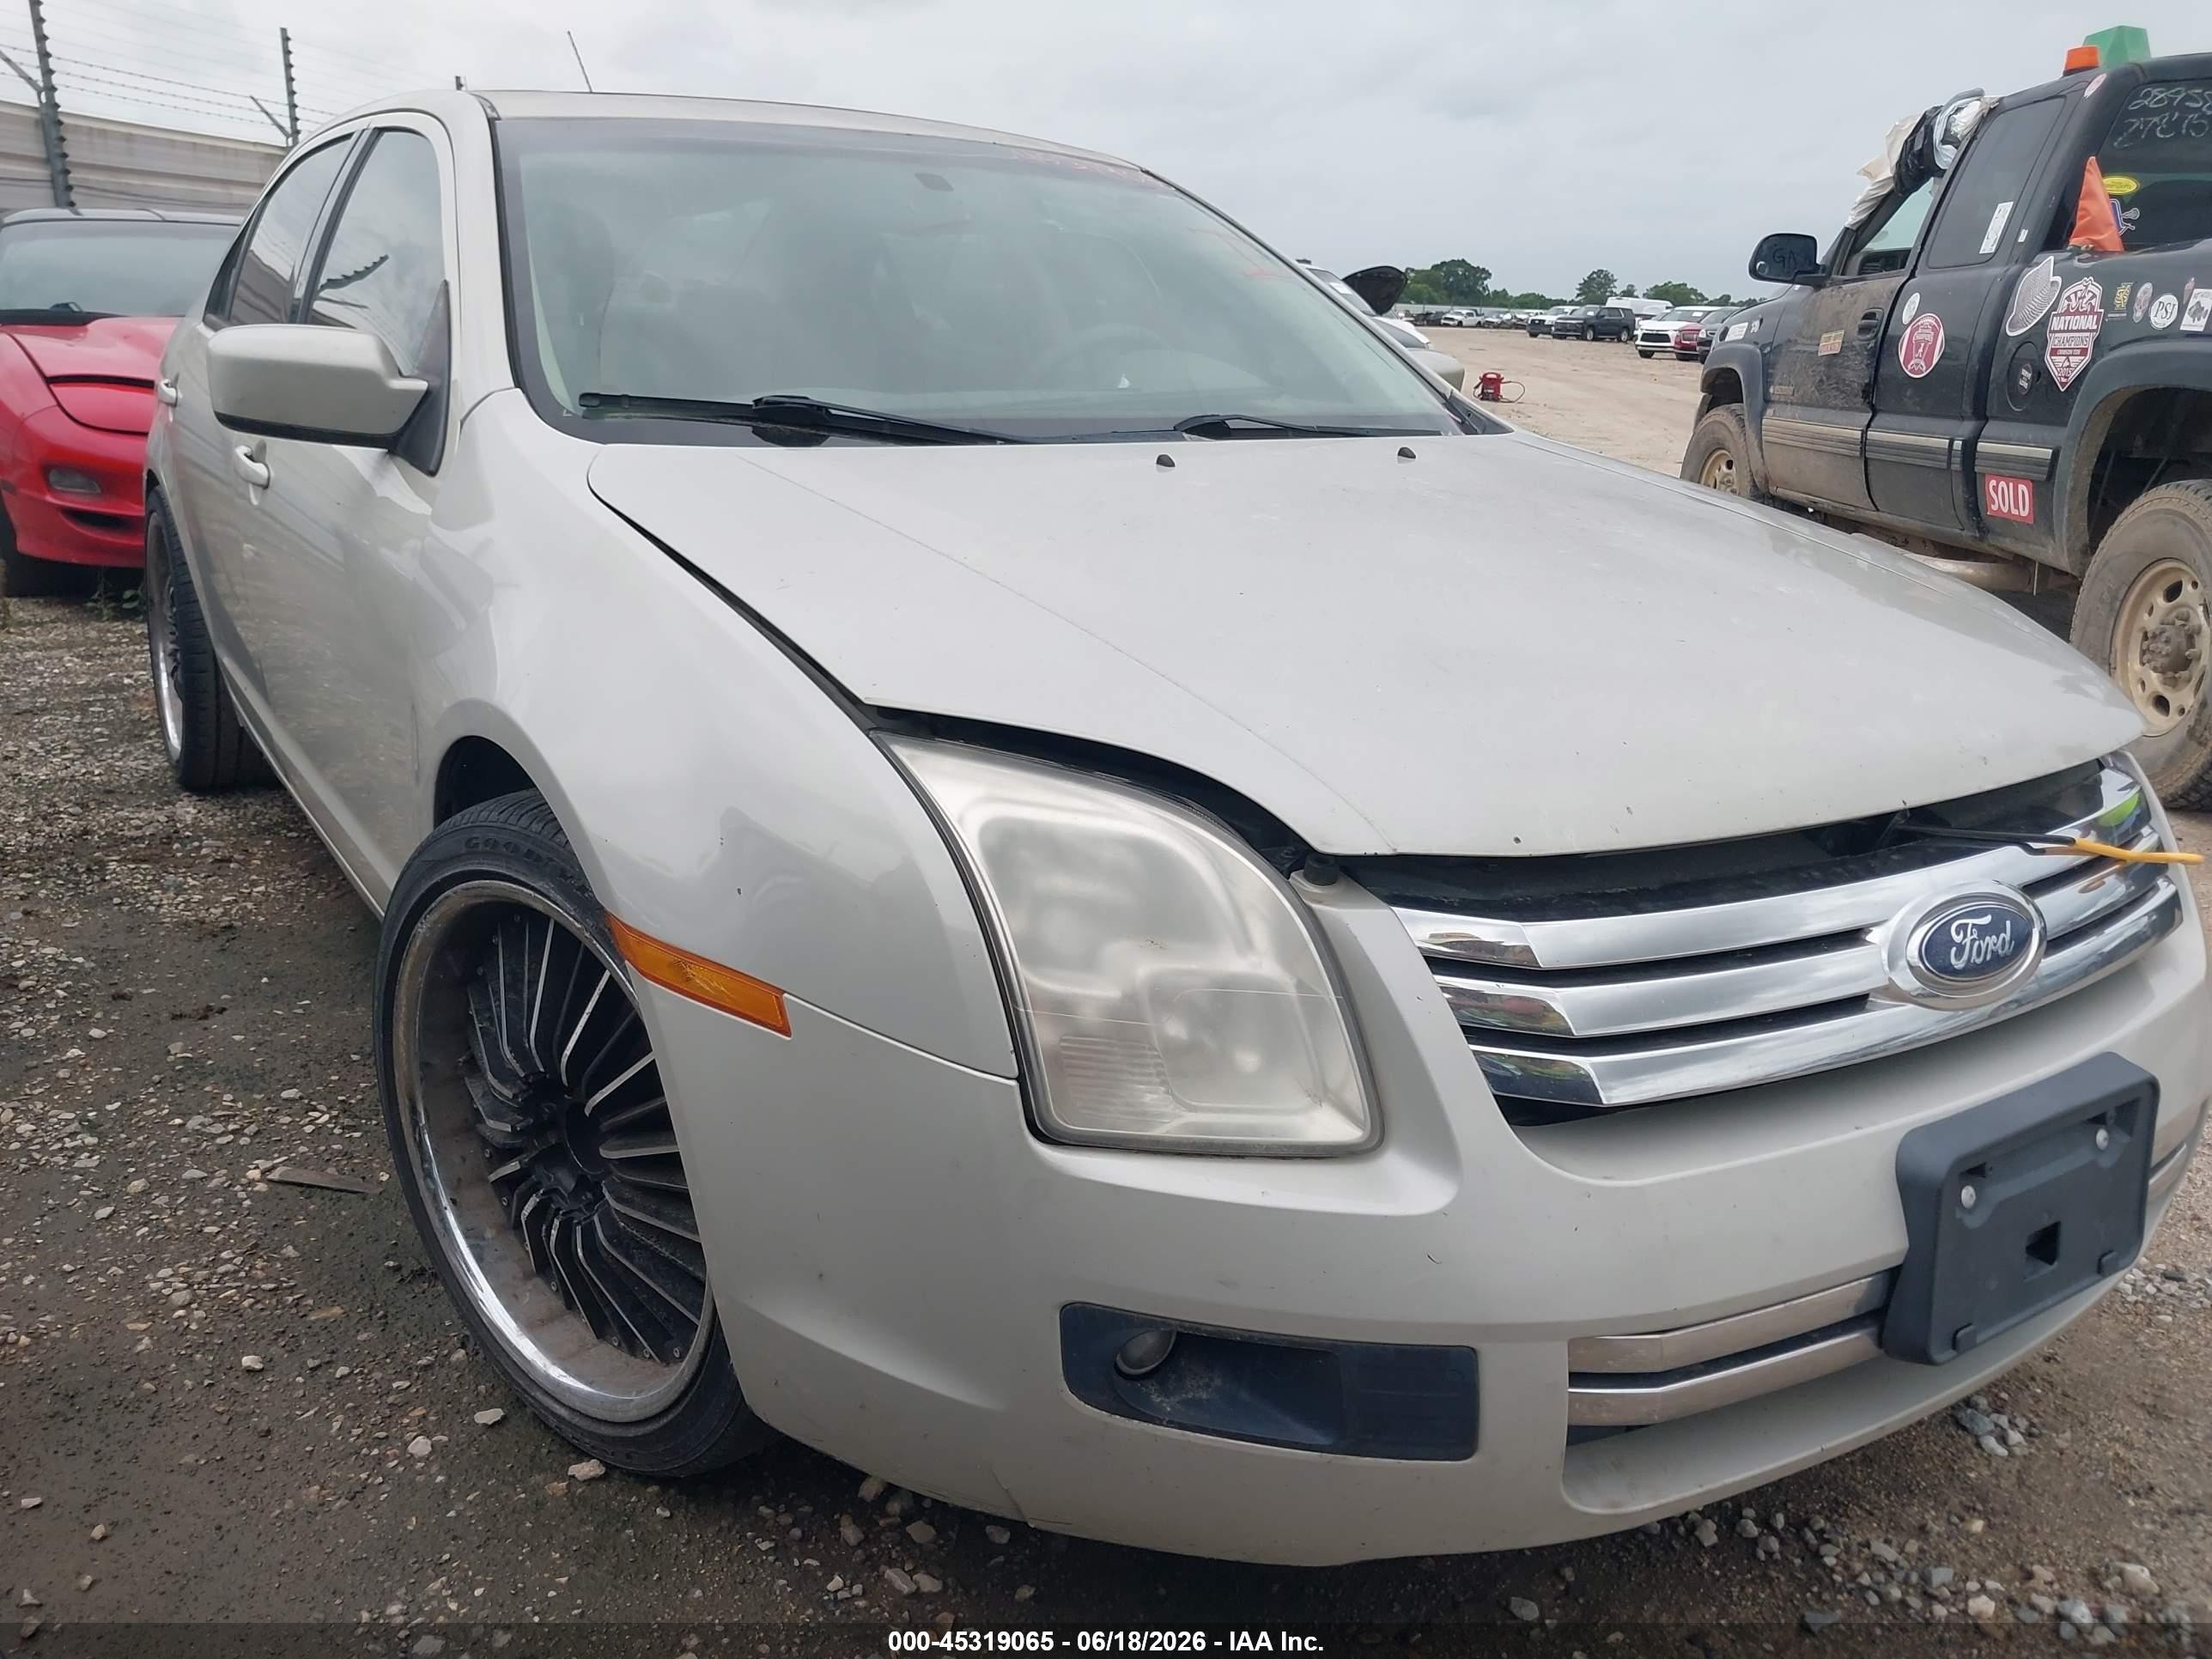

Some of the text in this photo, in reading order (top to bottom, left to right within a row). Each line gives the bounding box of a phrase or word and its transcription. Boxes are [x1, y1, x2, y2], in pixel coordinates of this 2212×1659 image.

[2051, 314, 2098, 331] NATIONAL
[2053, 335, 2089, 347] CHAMPIONS
[1989, 479, 2030, 517] SOLD
[1950, 914, 2015, 970] Ford
